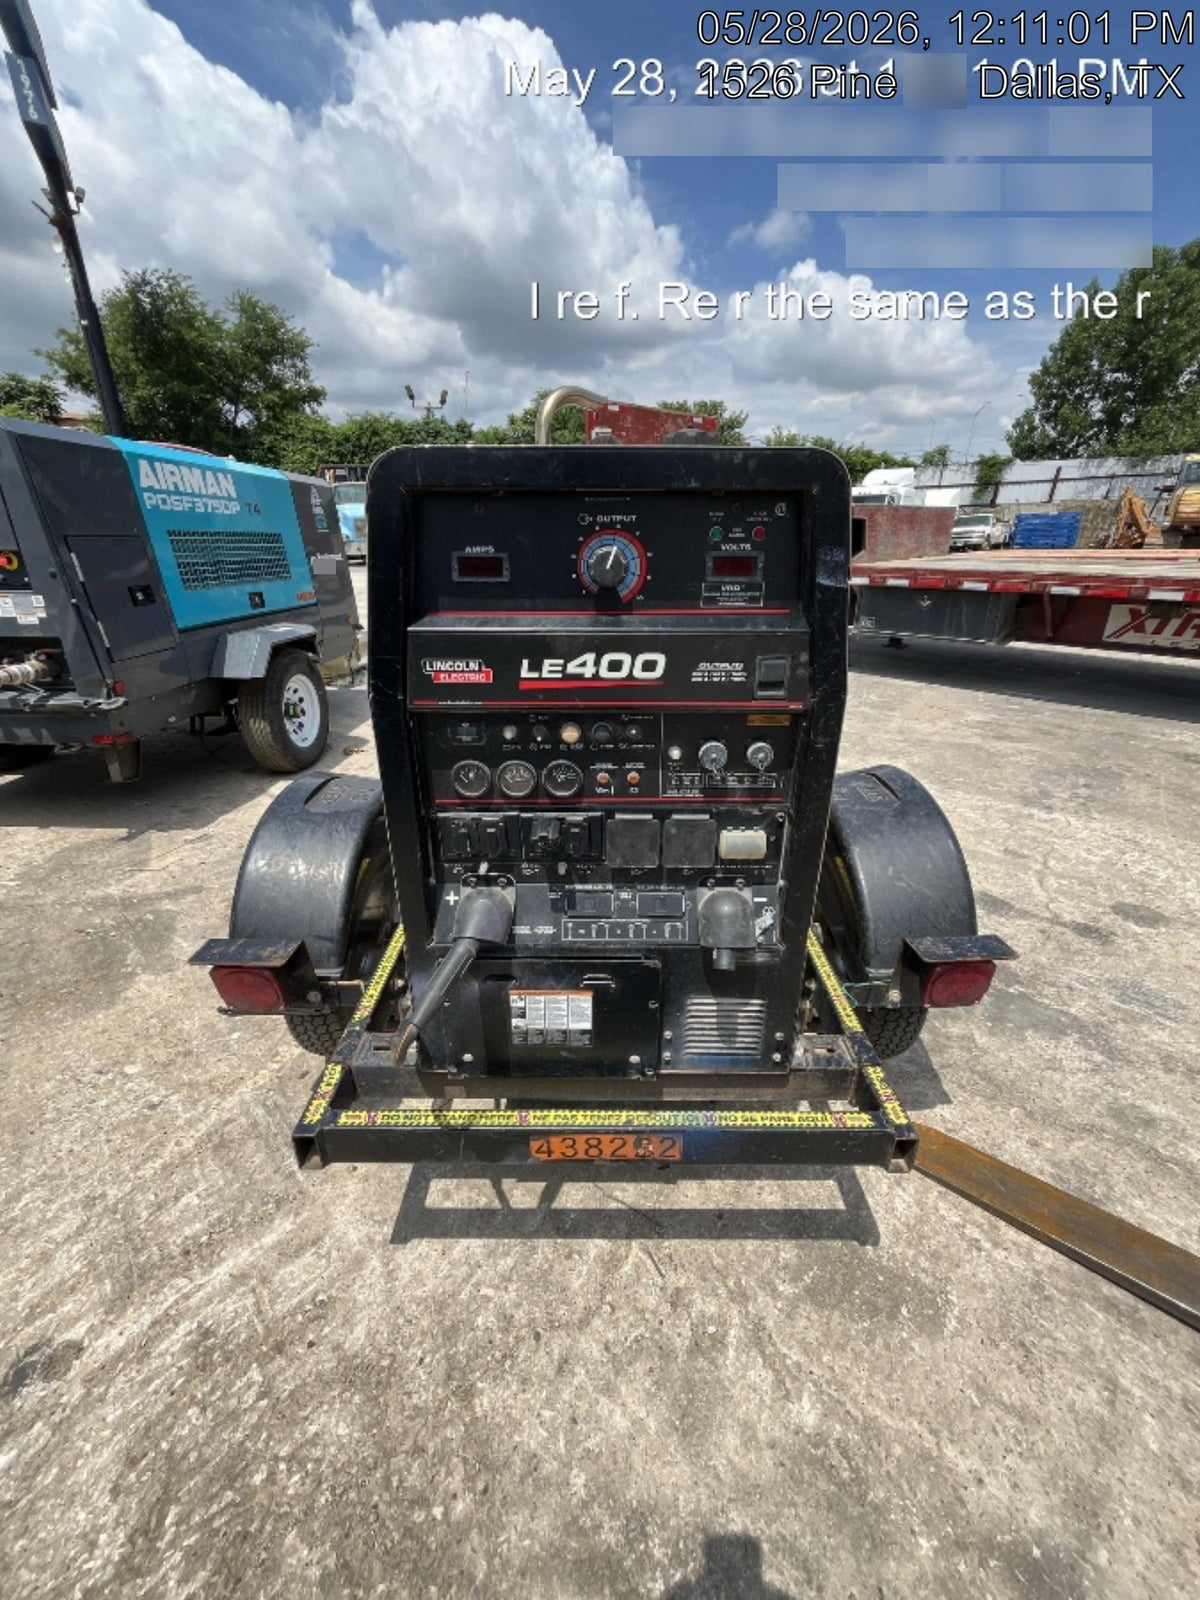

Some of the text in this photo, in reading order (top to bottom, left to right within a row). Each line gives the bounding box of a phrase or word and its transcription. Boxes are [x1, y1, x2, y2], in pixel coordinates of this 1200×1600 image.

[138, 459, 237, 499] AIRMAN
[596, 514, 638, 523] OUTPUT
[465, 545, 496, 554] AMPS
[720, 543, 753, 552] VOLTS
[425, 660, 480, 671] LINCOLN
[519, 651, 667, 680] LE400
[439, 673, 487, 682] ELECTRIC
[403, 1113, 431, 1122] NOT
